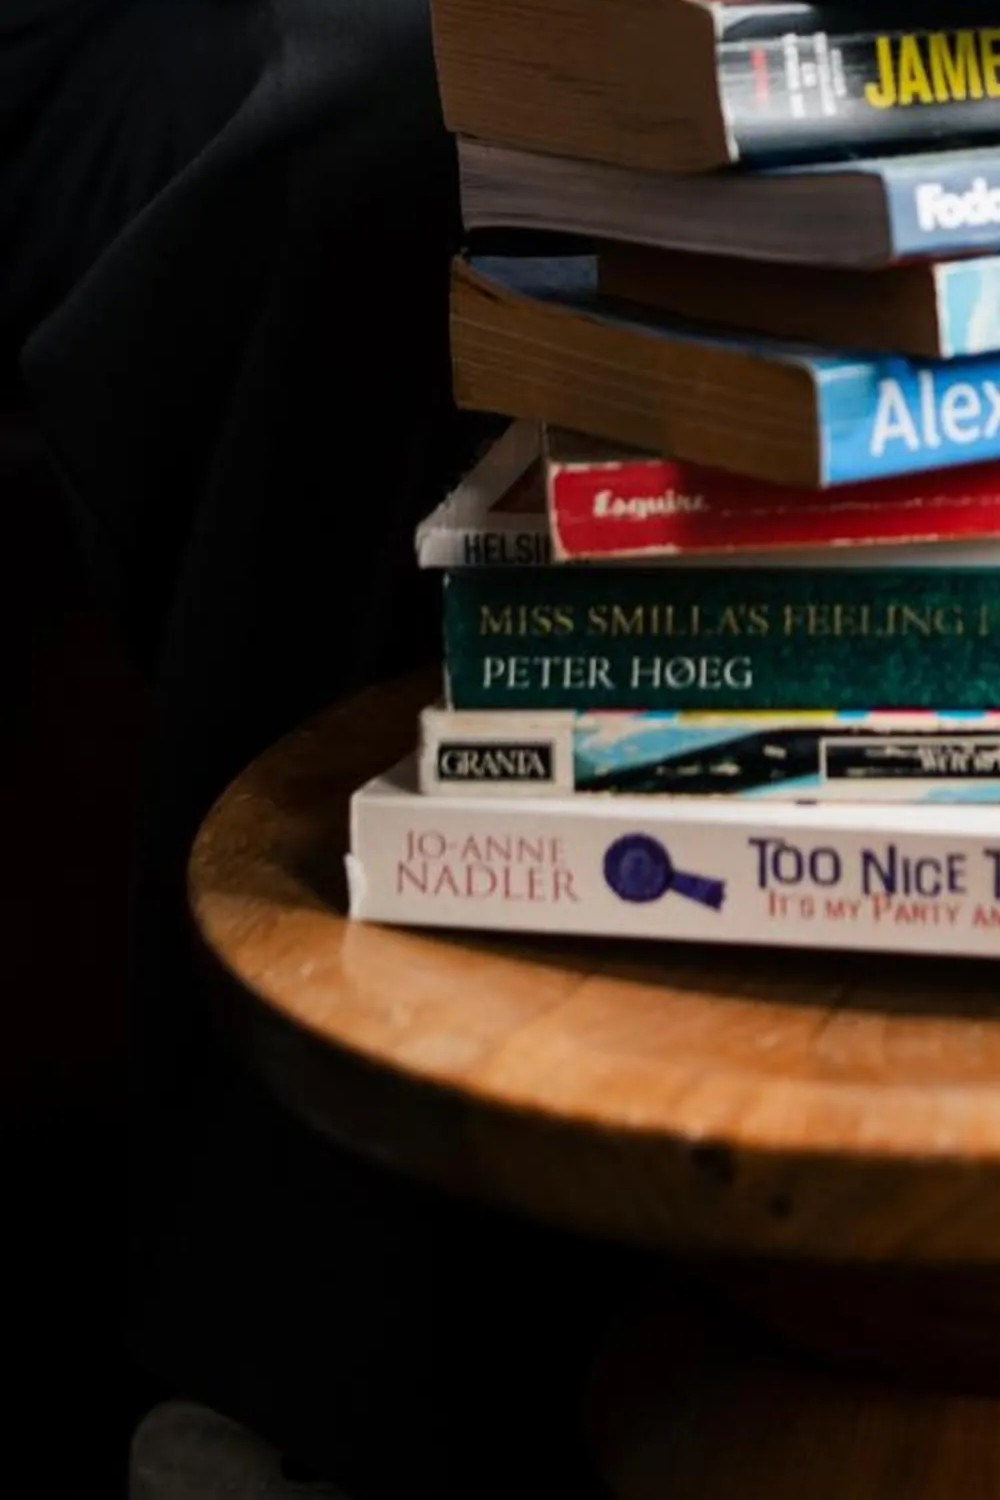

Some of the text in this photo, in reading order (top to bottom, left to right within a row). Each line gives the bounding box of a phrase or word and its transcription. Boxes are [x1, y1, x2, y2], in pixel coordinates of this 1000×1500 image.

[463, 532, 592, 565] HELSI
[480, 604, 574, 636] MISS
[587, 603, 770, 636] SMILLA'S
[784, 603, 964, 637] FEELING
[483, 655, 752, 690] PETER HØEG
[440, 749, 546, 777] GRANTA
[405, 829, 564, 864] JO-ANNE
[396, 860, 579, 902] NADLER
